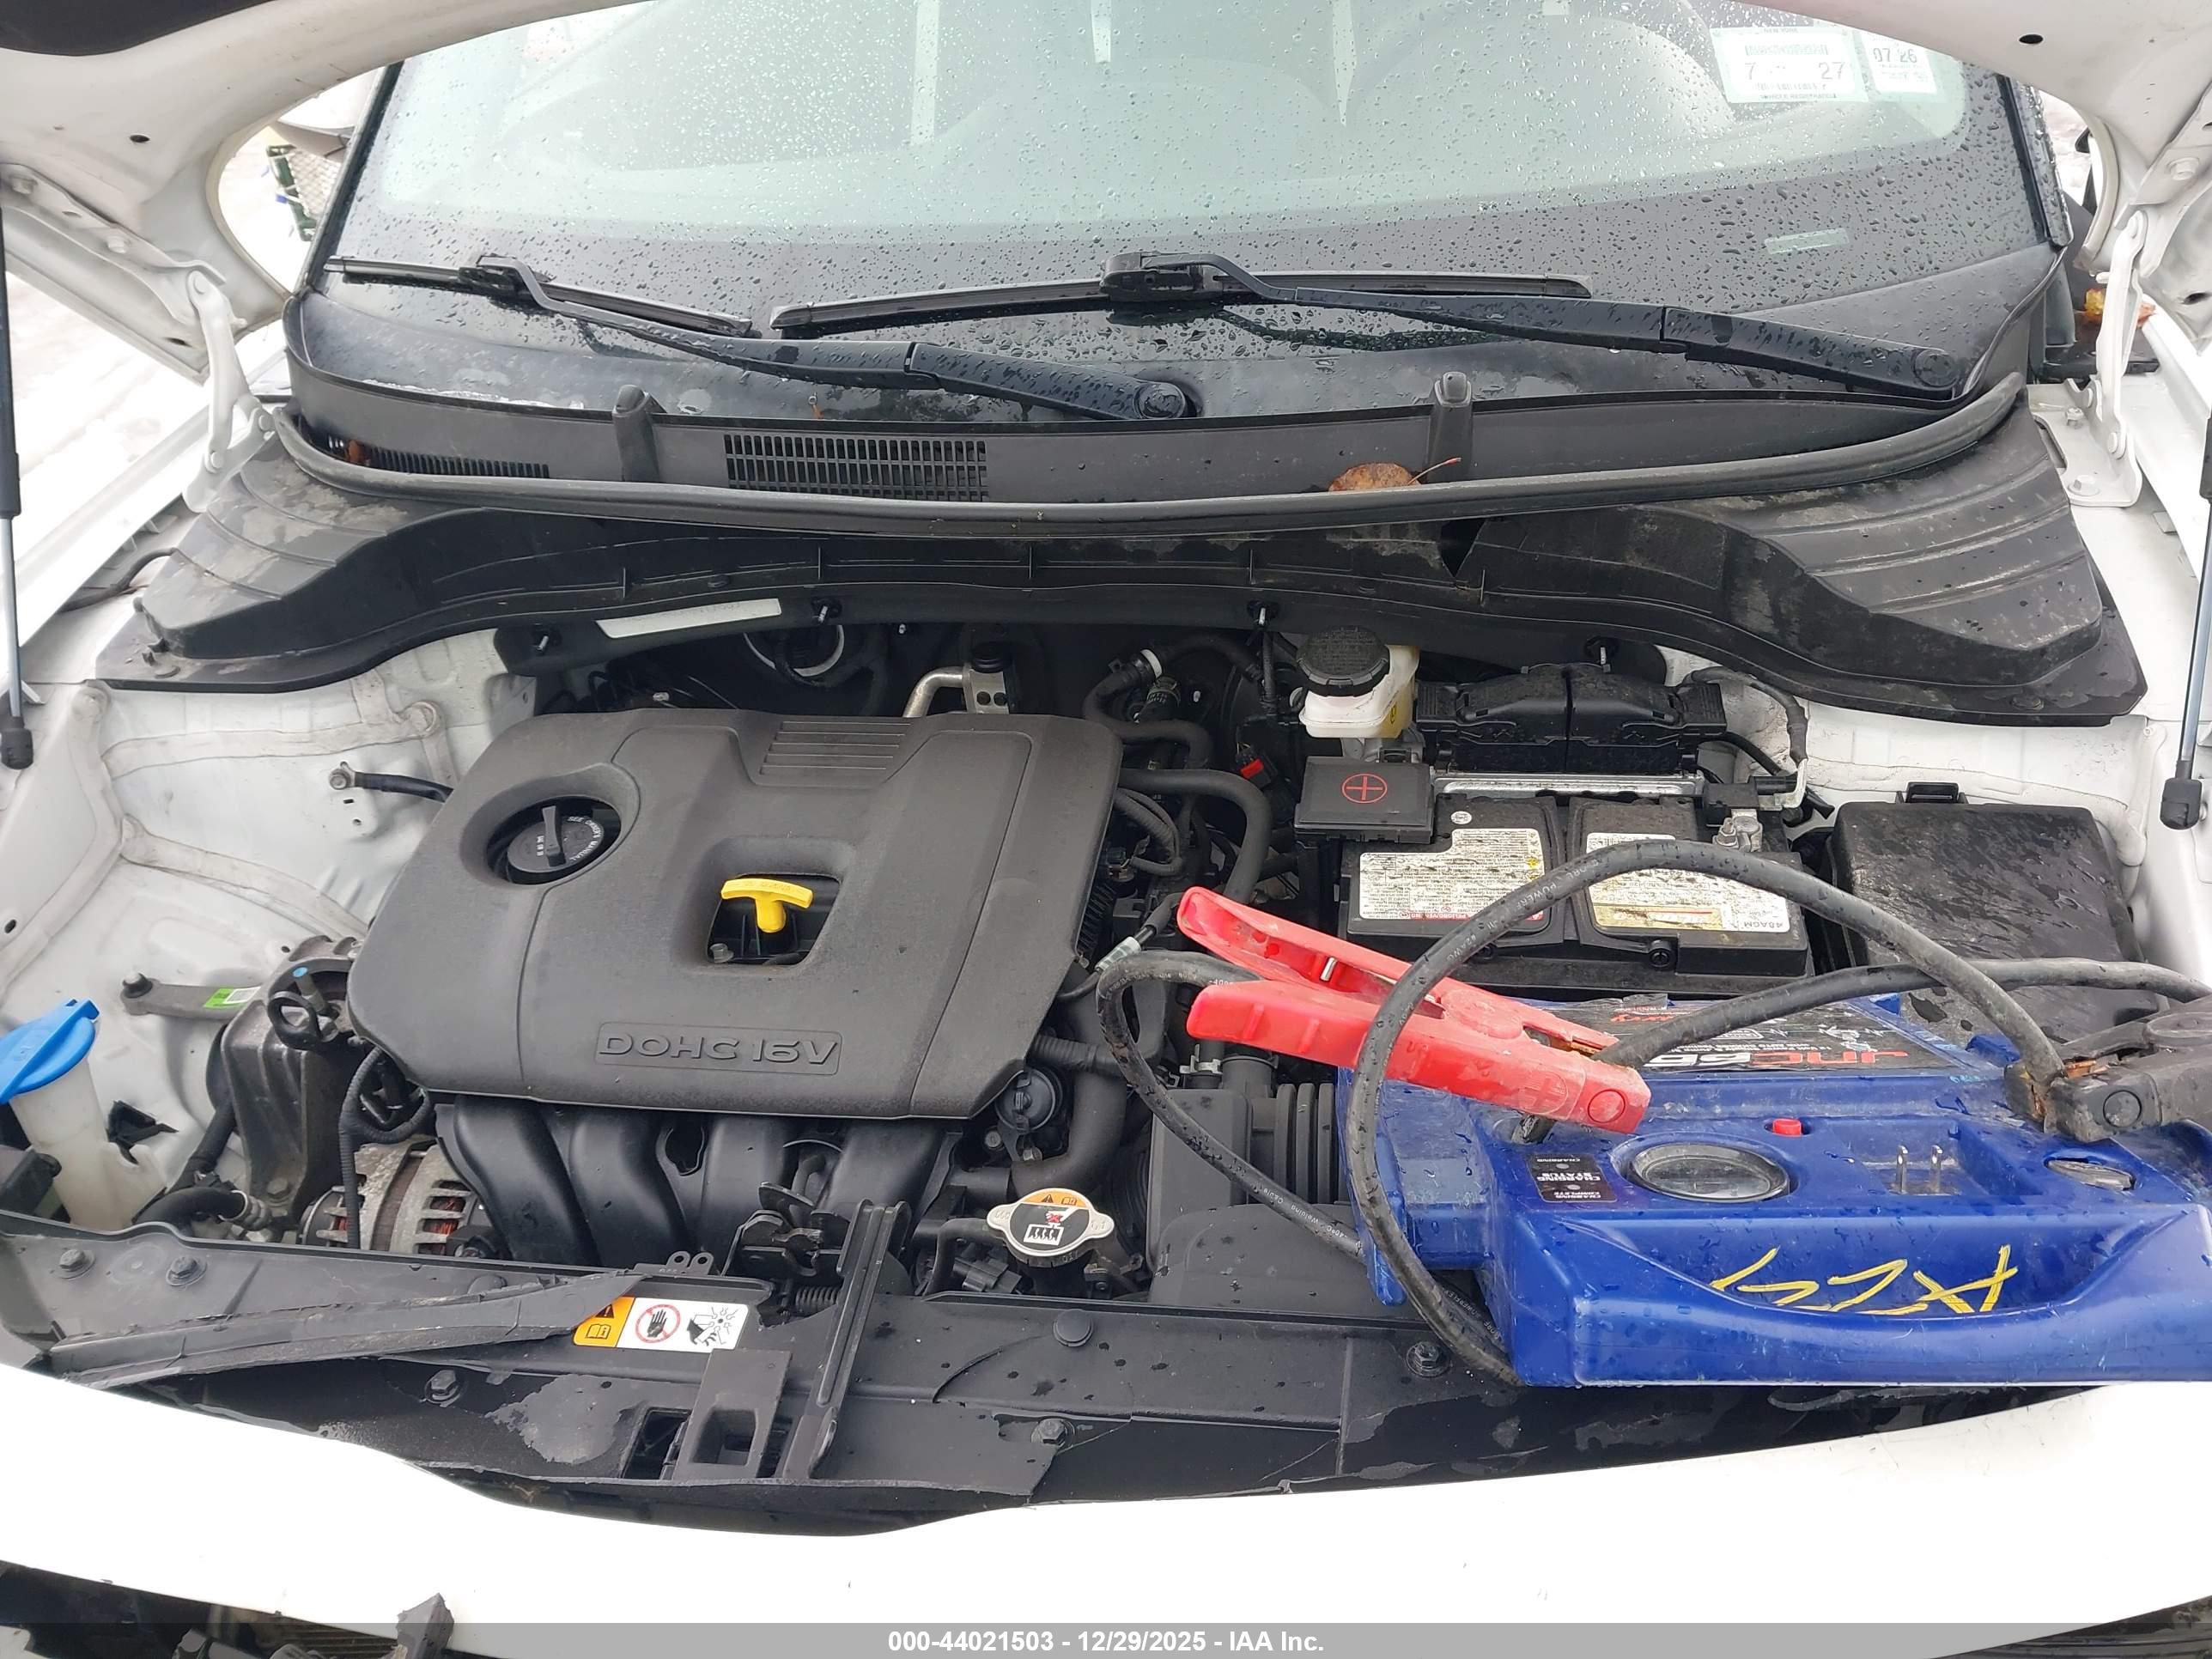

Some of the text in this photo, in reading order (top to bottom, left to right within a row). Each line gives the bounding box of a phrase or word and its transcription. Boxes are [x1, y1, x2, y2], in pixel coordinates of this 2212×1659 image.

[1873, 47, 1891, 63] 07
[1744, 61, 1846, 81] 7 27
[568, 841, 599, 861] MANUAL
[599, 1031, 839, 1065] DOHC 16V
[1263, 1188, 1285, 1205] Cable
[1290, 1205, 1320, 1224] Welding
